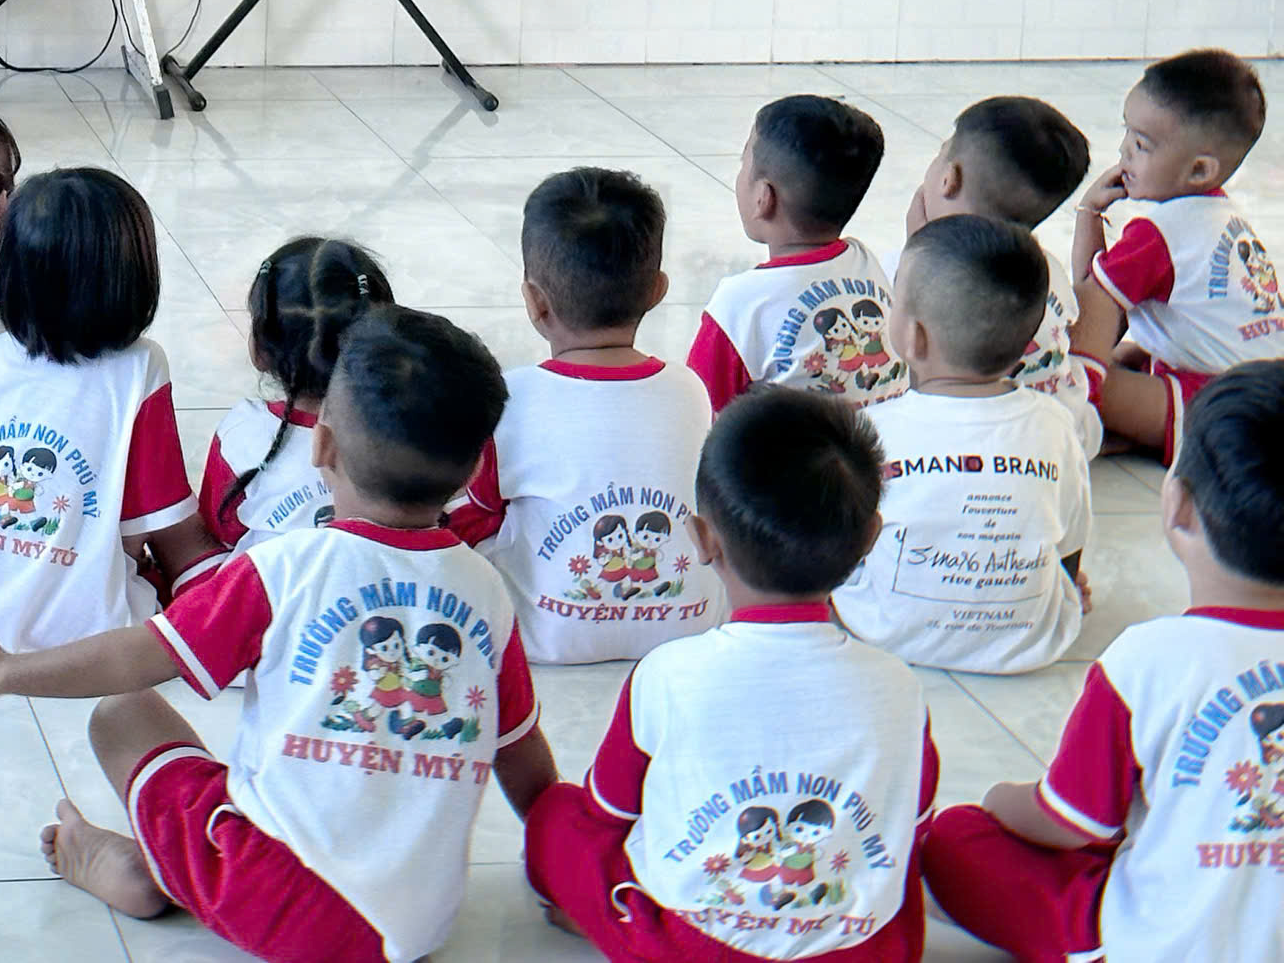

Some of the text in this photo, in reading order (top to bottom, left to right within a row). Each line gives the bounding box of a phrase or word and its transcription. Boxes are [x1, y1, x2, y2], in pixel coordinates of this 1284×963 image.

[841, 277, 876, 298] NON
[33, 423, 69, 453] NON
[65, 448, 96, 486] PHÚ
[993, 456, 1059, 482] BRAND
[590, 481, 635, 514] MẦM
[640, 487, 676, 511] NON
[12, 538, 46, 560] MỸ
[50, 546, 79, 567] TÚ
[537, 594, 709, 624] HUYỆN MỸ TÚ
[952, 609, 1016, 621] VIETNAM
[289, 596, 360, 686] TRƯỜNG
[427, 585, 473, 629] NON
[1171, 686, 1245, 787] TRƯỜNG
[282, 733, 403, 775] HUYỆN
[412, 752, 465, 781] MỸ
[664, 792, 732, 863] TRƯỜNG
[730, 764, 788, 805] MẦM
[796, 772, 843, 803] NON
[842, 791, 877, 833] PHÚ
[838, 911, 877, 935] TÚ
